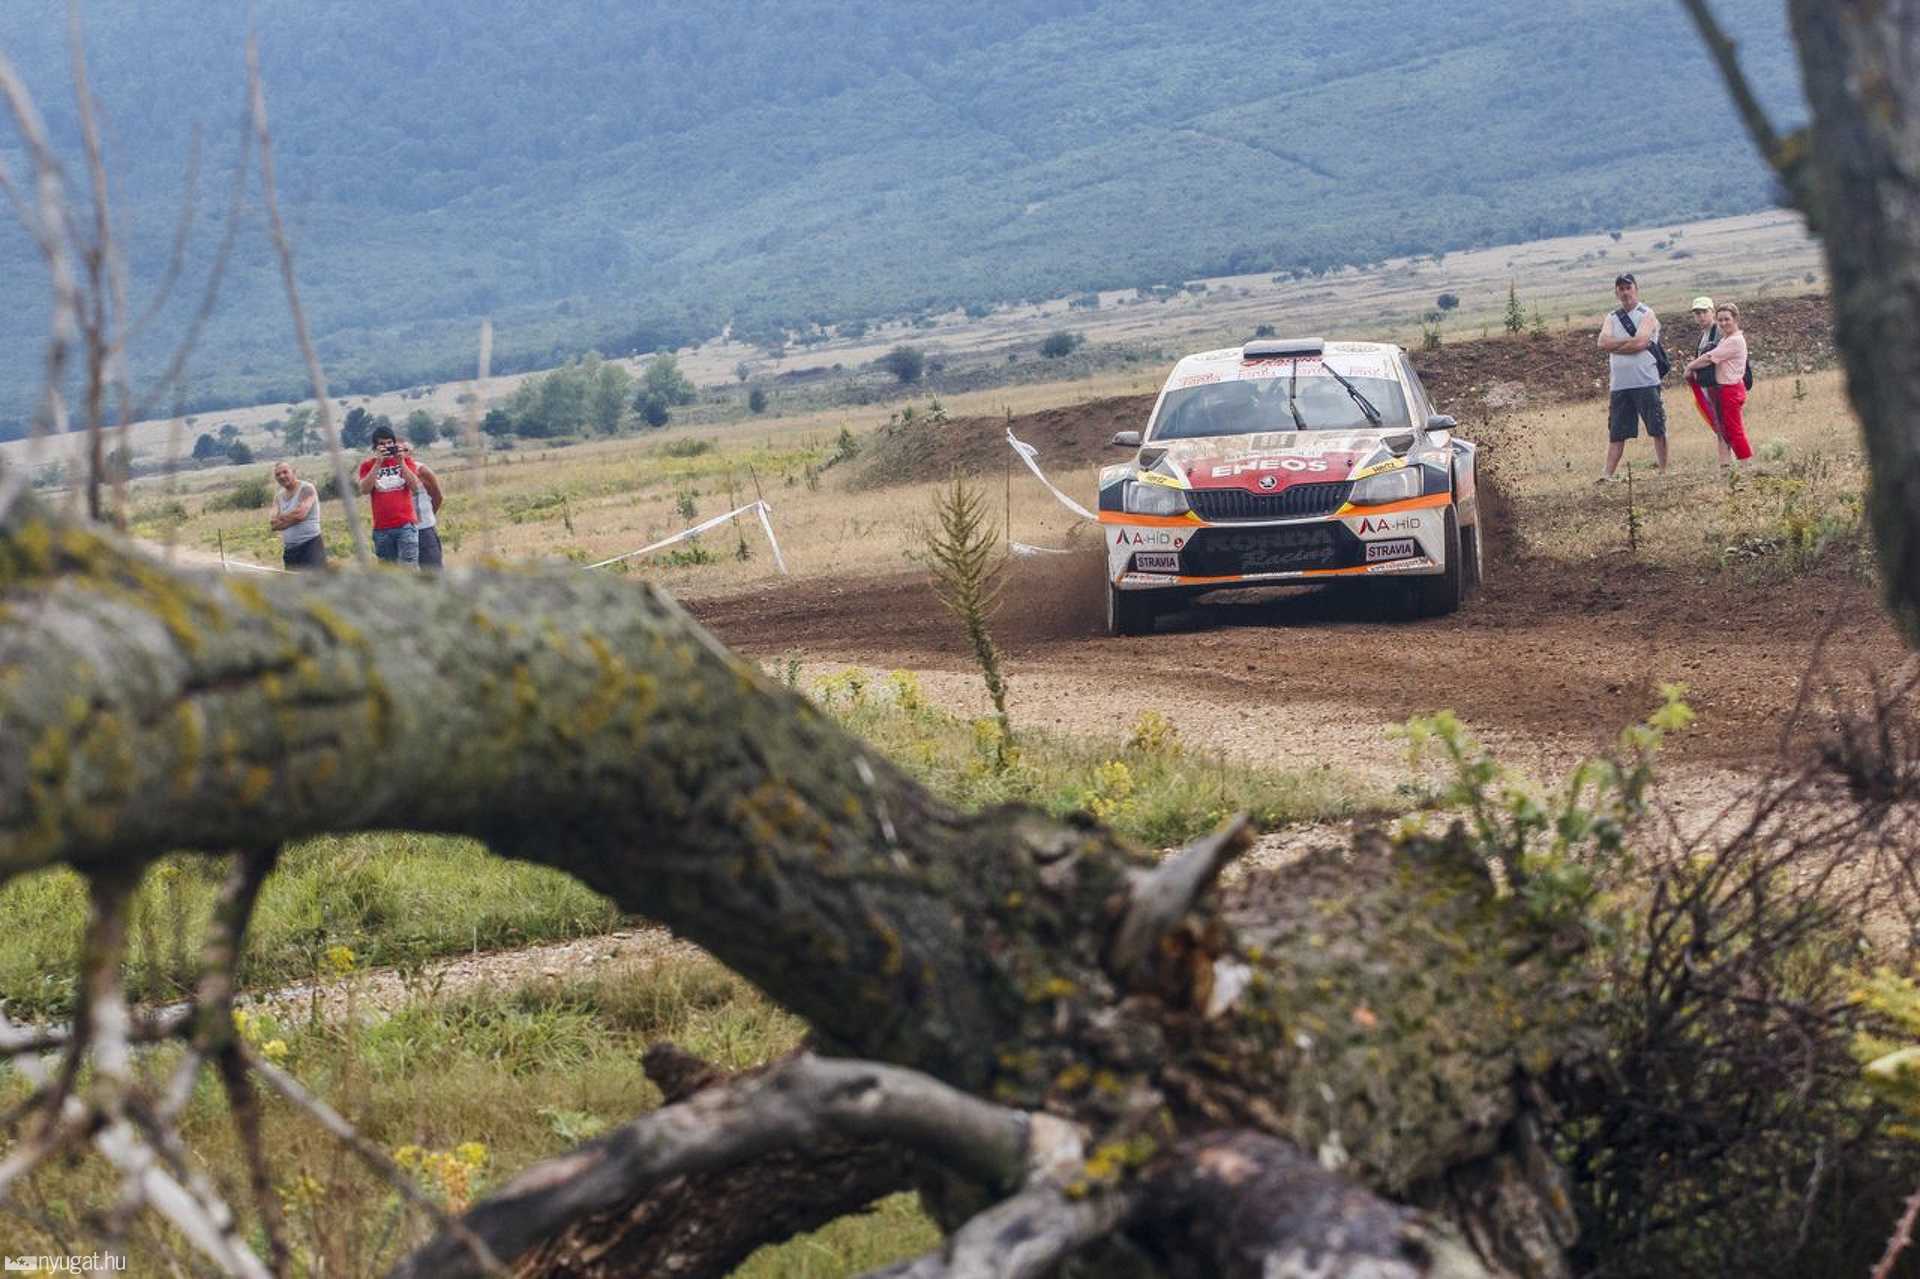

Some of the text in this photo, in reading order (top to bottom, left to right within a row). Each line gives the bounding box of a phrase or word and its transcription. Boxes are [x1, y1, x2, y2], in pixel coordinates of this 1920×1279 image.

[1211, 458, 1328, 478] ENEOS
[1368, 543, 1412, 558] STRAVIA
[1138, 556, 1177, 568] STRAVIA
